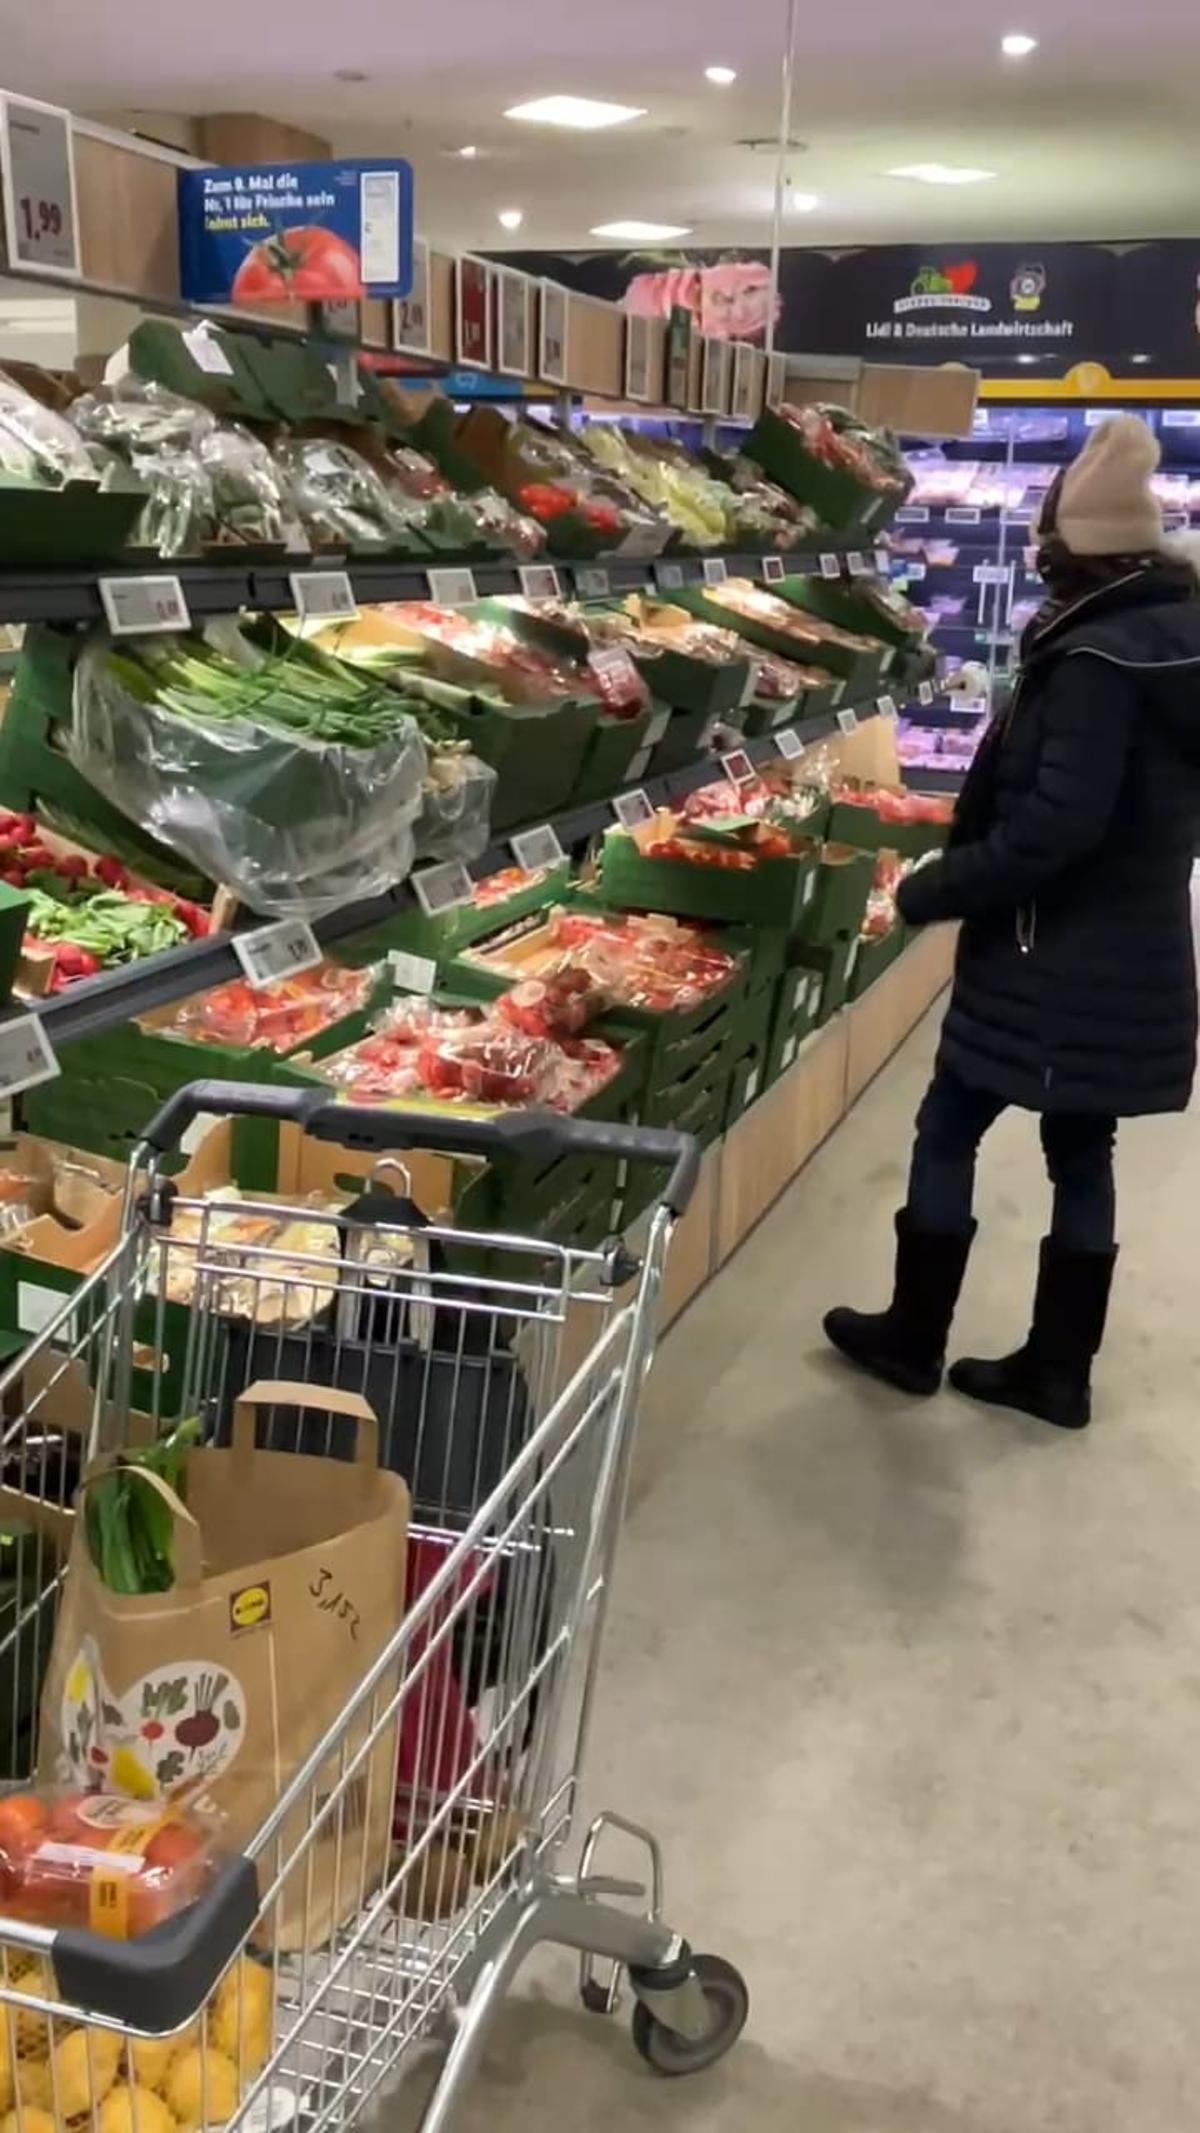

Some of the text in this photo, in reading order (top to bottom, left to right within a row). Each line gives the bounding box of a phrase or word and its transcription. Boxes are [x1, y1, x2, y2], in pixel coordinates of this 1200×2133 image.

[204, 178, 232, 194] Zum
[248, 174, 274, 191] Mal
[276, 172, 299, 191] die
[234, 194, 253, 211] für
[255, 192, 302, 209] Frische
[306, 189, 336, 207] sein
[204, 211, 271, 231] lohnt sich.
[866, 319, 1074, 338] Lidl & Deutsche Landwirtschaft
